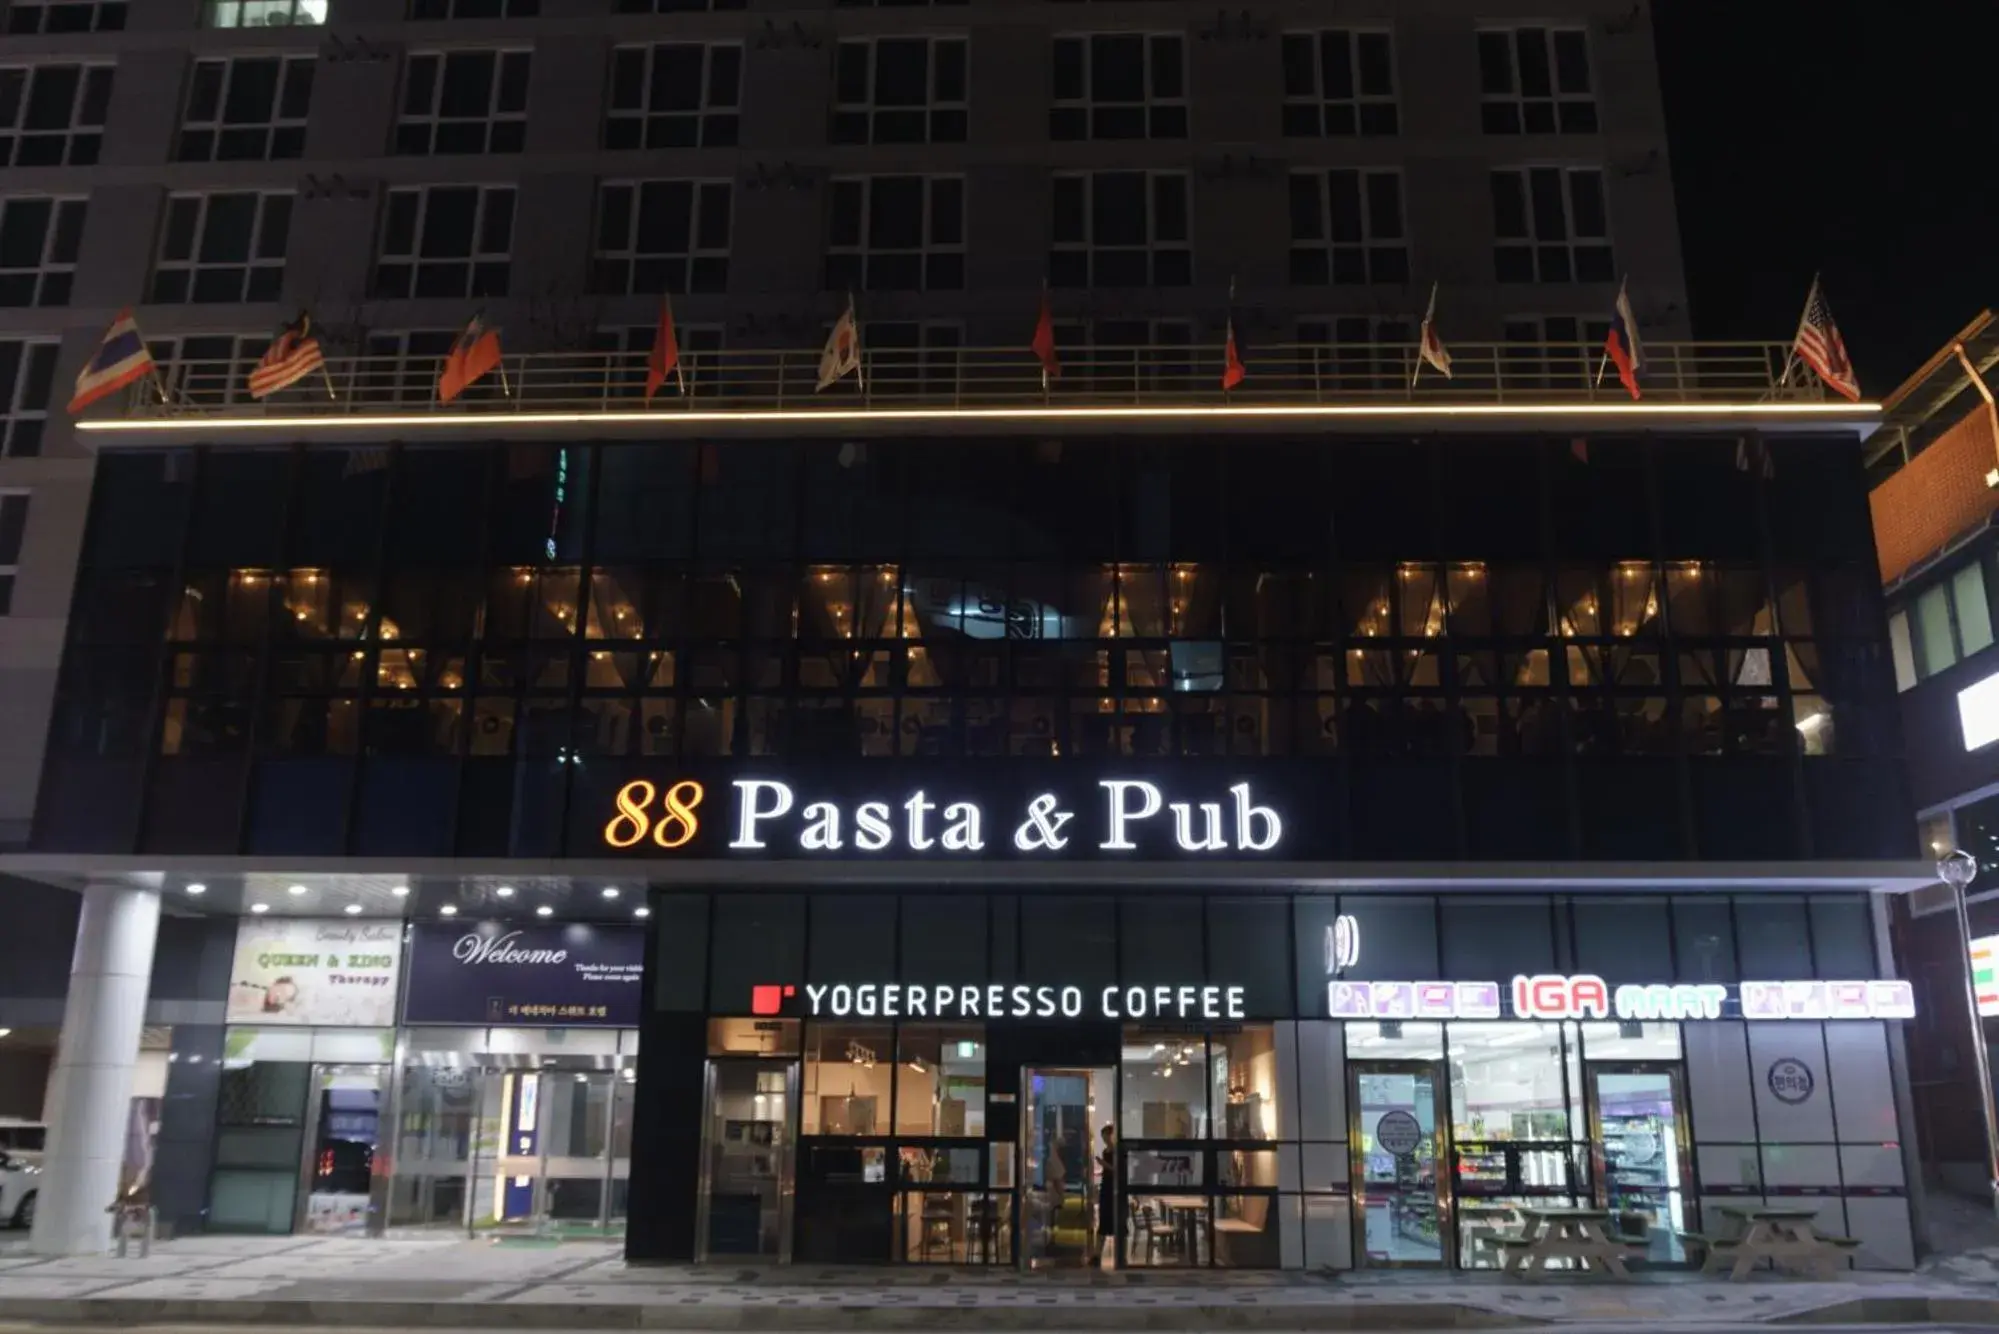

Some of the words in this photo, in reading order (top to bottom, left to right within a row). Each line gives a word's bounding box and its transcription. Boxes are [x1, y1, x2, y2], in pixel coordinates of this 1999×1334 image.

[604, 779, 704, 848] 88
[728, 779, 985, 852] Pasta
[1013, 792, 1074, 852] &
[1098, 779, 1282, 852] Pub
[258, 953, 319, 969] QUEEN
[327, 954, 339, 968] &
[453, 930, 568, 965] Welcome
[329, 975, 390, 987] Therapy
[1514, 976, 1607, 1018] IGA
[806, 984, 1082, 1017] YOGERPRESSO
[1101, 986, 1245, 1018] COFFEE
